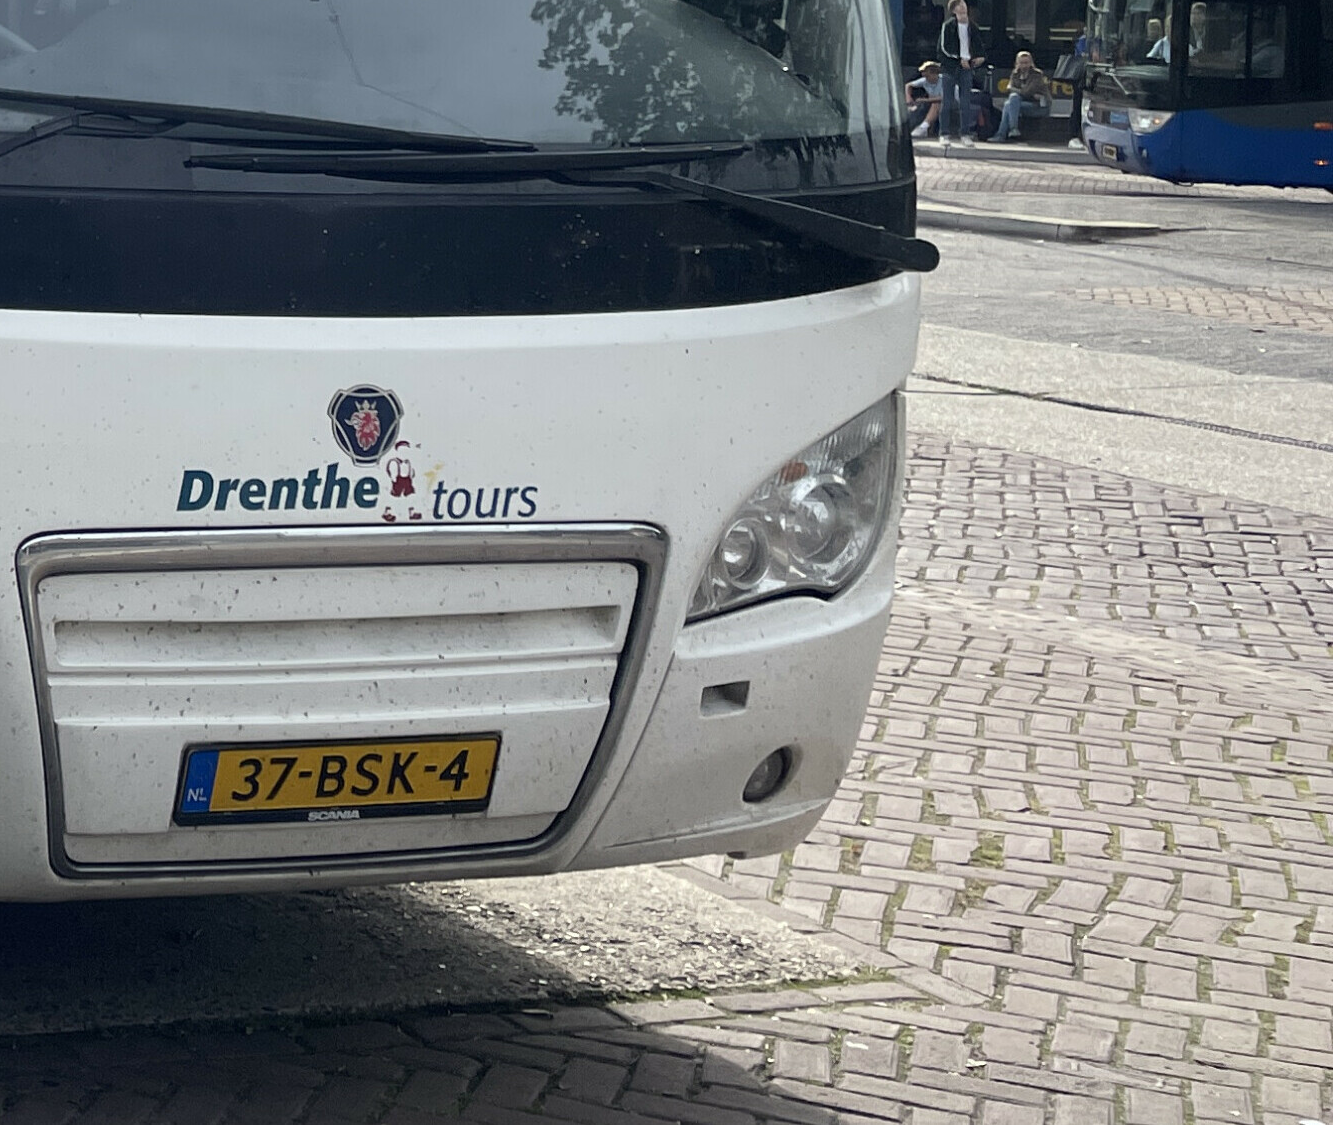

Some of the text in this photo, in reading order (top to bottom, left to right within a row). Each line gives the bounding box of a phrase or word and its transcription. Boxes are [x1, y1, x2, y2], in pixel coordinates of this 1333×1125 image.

[176, 462, 539, 521] Drenthe tours
[230, 748, 470, 802] 37-BSK-4
[186, 787, 208, 803] NL
[307, 809, 361, 822] SCANIA
